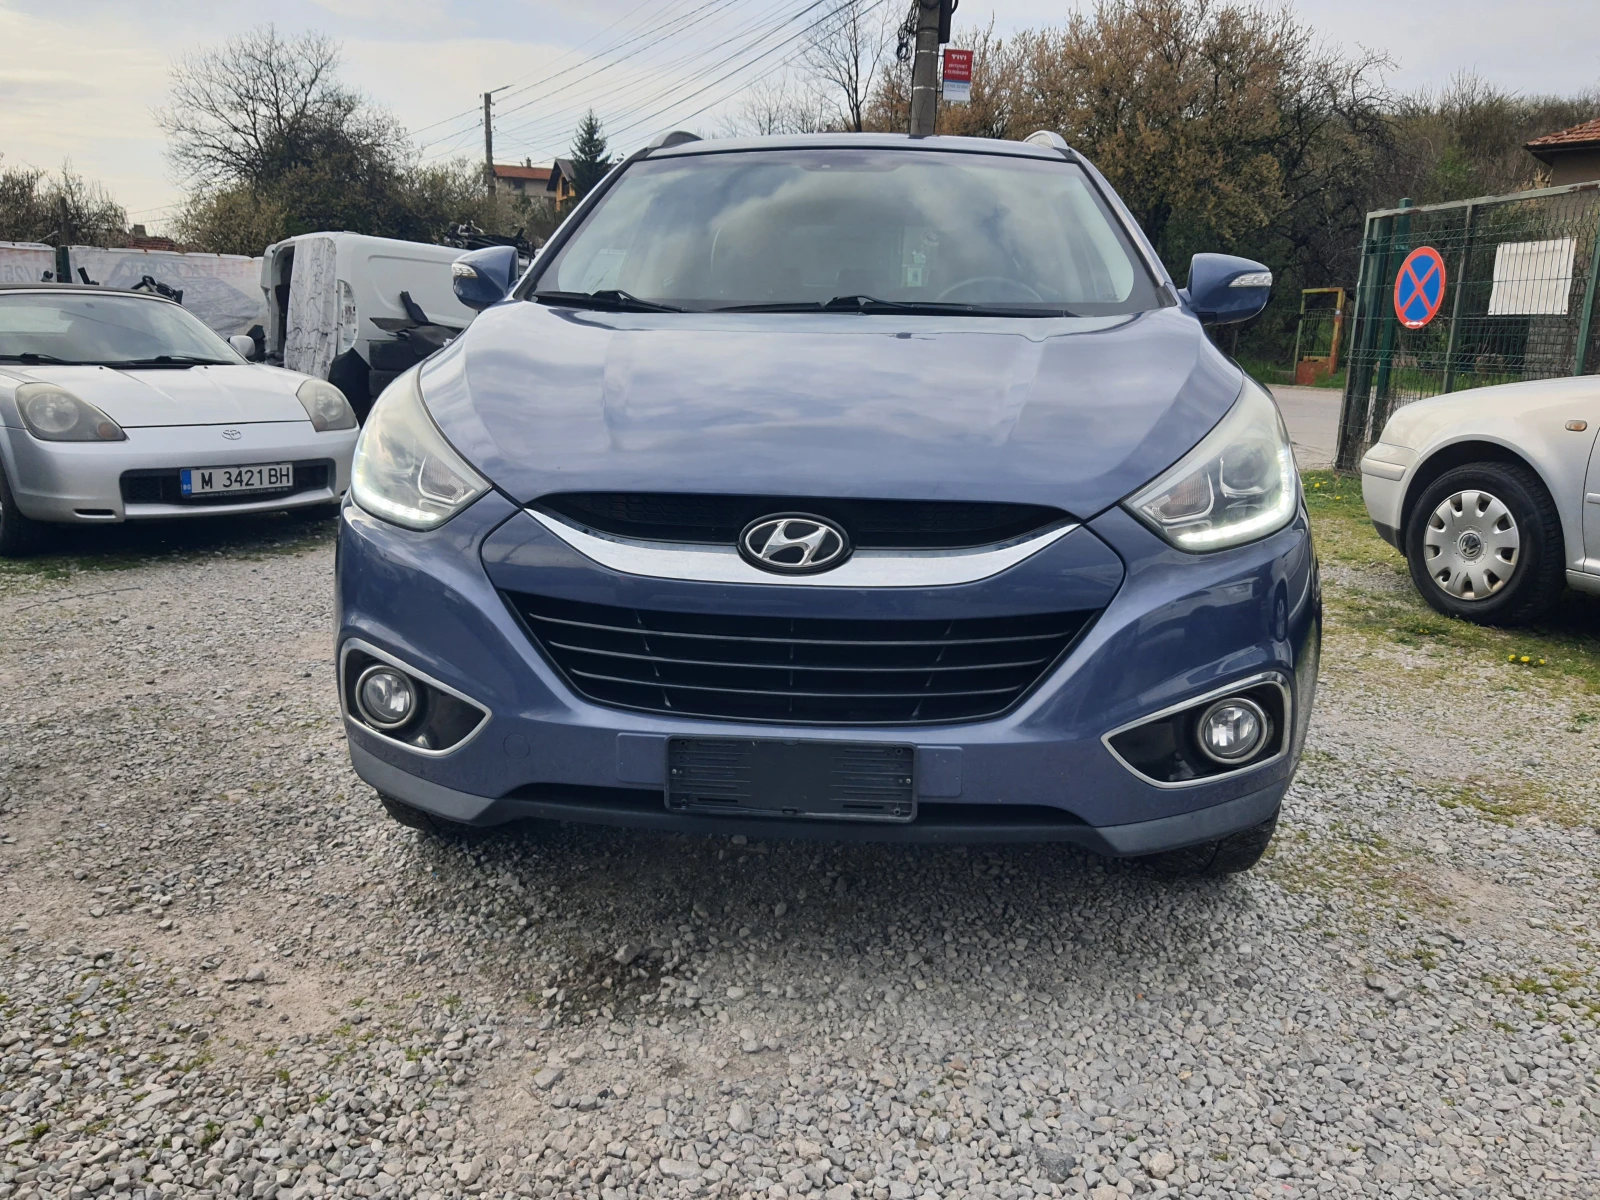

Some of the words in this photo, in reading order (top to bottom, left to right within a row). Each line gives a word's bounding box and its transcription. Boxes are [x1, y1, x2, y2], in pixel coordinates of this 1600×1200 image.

[201, 472, 213, 489] M
[223, 469, 263, 488] 3421
[268, 467, 290, 484] BH
